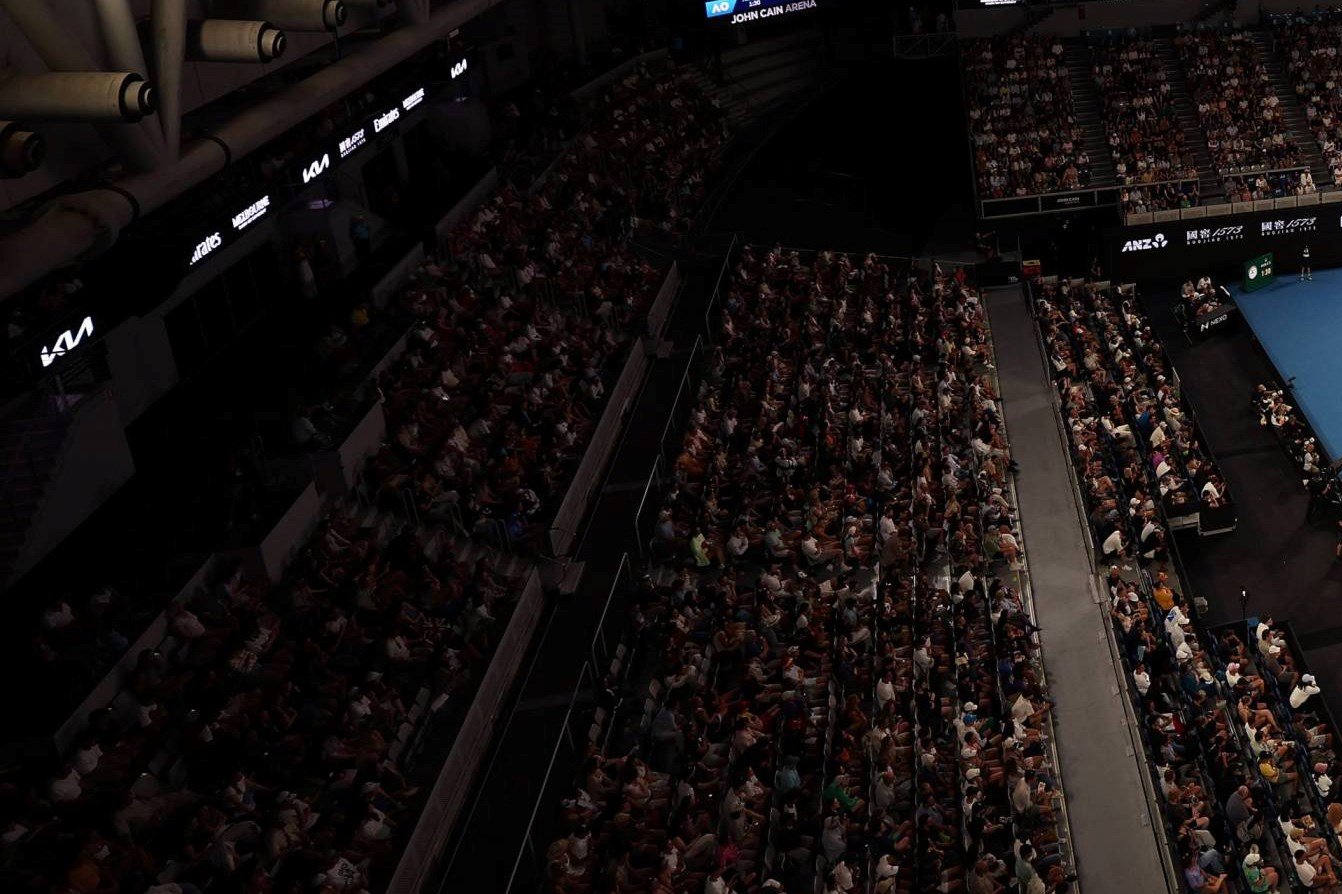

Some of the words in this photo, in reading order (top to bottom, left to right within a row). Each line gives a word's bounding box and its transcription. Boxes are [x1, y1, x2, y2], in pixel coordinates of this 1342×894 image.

[731, 11, 759, 24] JOHN
[760, 5, 784, 18] CAIN
[785, 0, 817, 13] ARENA
[1285, 217, 1317, 228] 1573
[1211, 225, 1244, 237] 1573
[1121, 238, 1153, 253] ANZ
